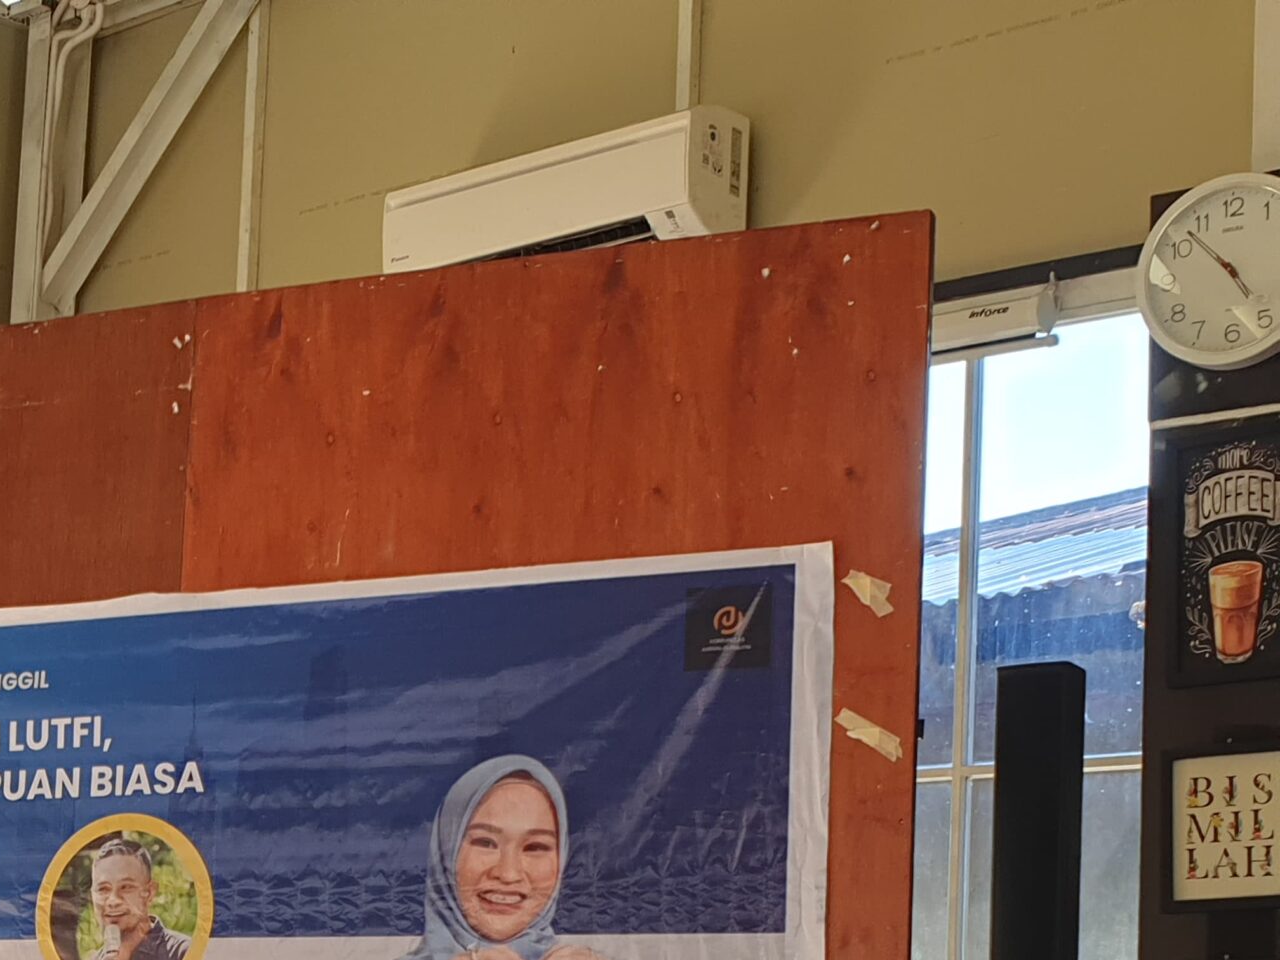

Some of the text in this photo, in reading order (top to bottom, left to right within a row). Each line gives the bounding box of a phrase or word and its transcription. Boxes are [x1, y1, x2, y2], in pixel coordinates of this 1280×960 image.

[1223, 197, 1245, 218] 12
[1263, 201, 1271, 221] 1
[1194, 213, 1209, 233] 11
[1171, 239, 1193, 260] 10
[1161, 273, 1176, 292] 9
[1171, 303, 1186, 323] 8
[1257, 308, 1273, 329] 5
[1191, 320, 1206, 340] 7
[1224, 323, 1241, 343] 6
[1201, 475, 1271, 520] COFFEE
[1204, 520, 1265, 558] PLEASE
[8, 715, 113, 753] LUTFI,
[90, 761, 205, 798] BIASA
